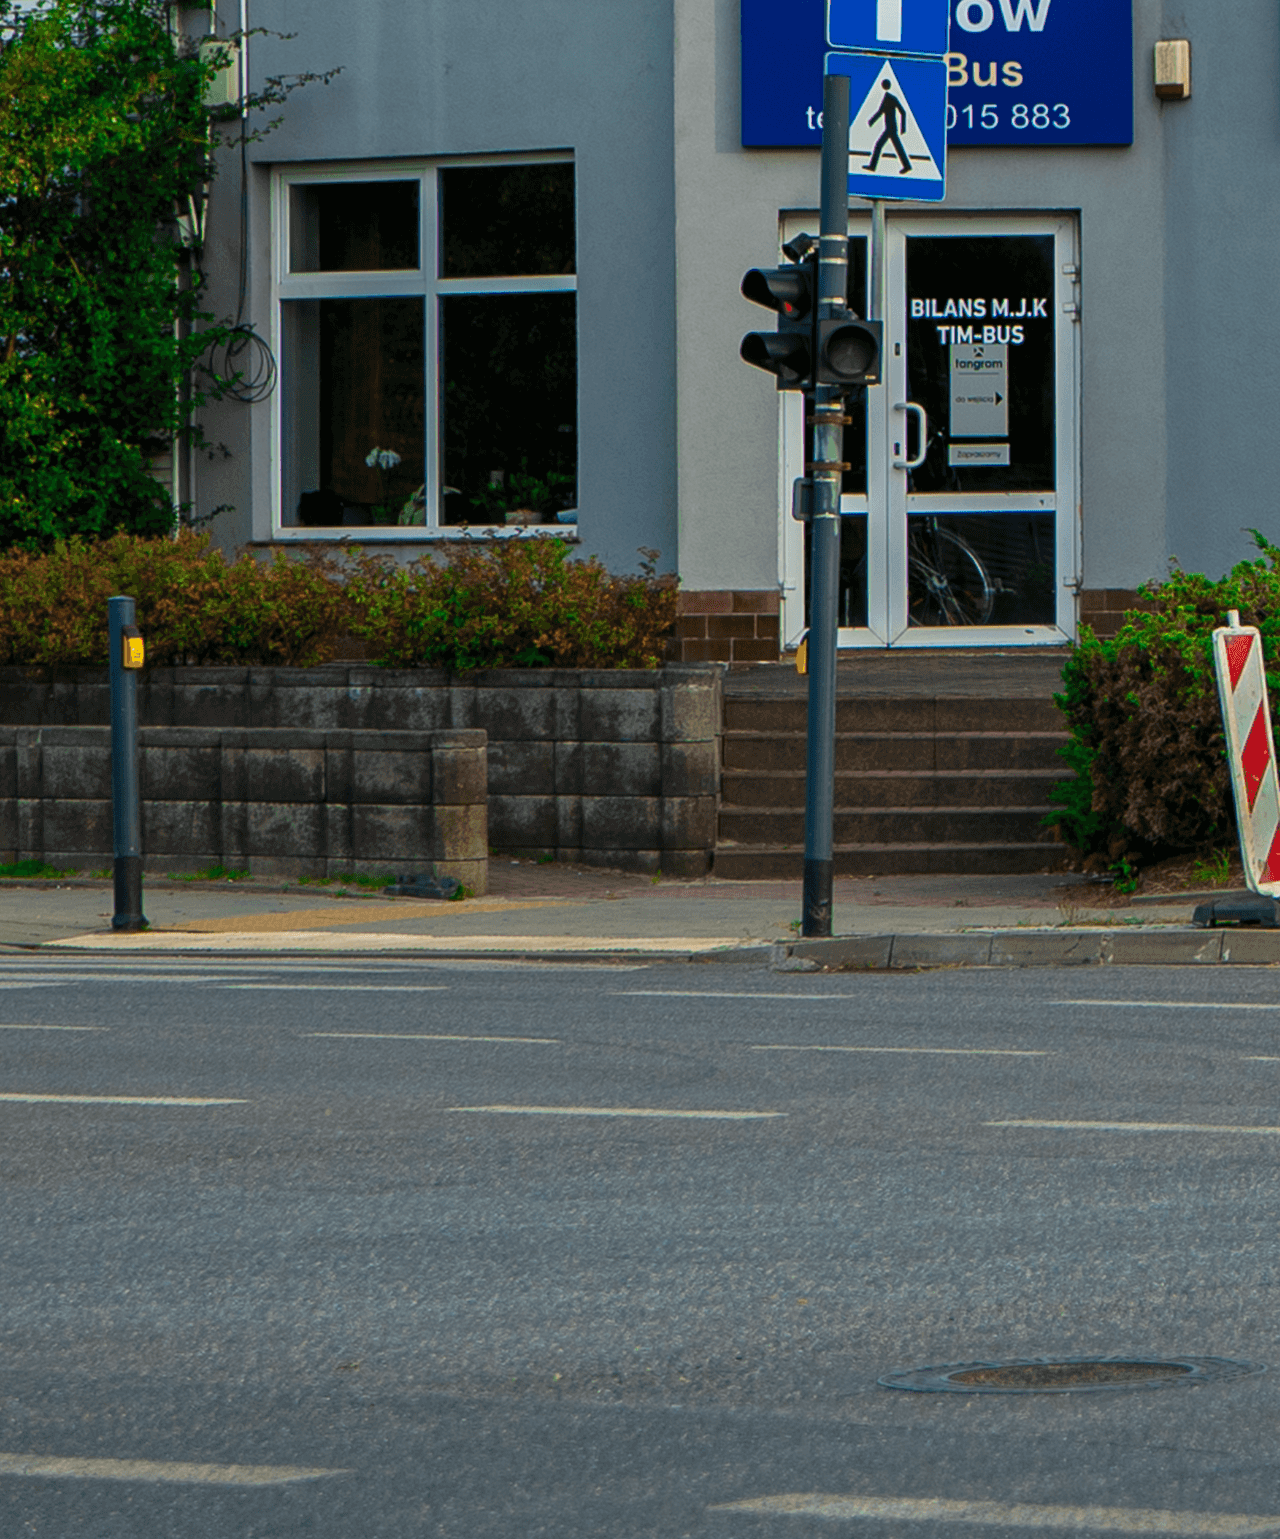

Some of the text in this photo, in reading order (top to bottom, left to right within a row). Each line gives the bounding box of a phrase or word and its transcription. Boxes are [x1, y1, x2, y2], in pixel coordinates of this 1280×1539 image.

[1011, 104, 1071, 130] 883
[910, 298, 1048, 319] BILANS M.J.K
[936, 325, 1025, 345] TIM-BUS
[955, 358, 1003, 371] tangram
